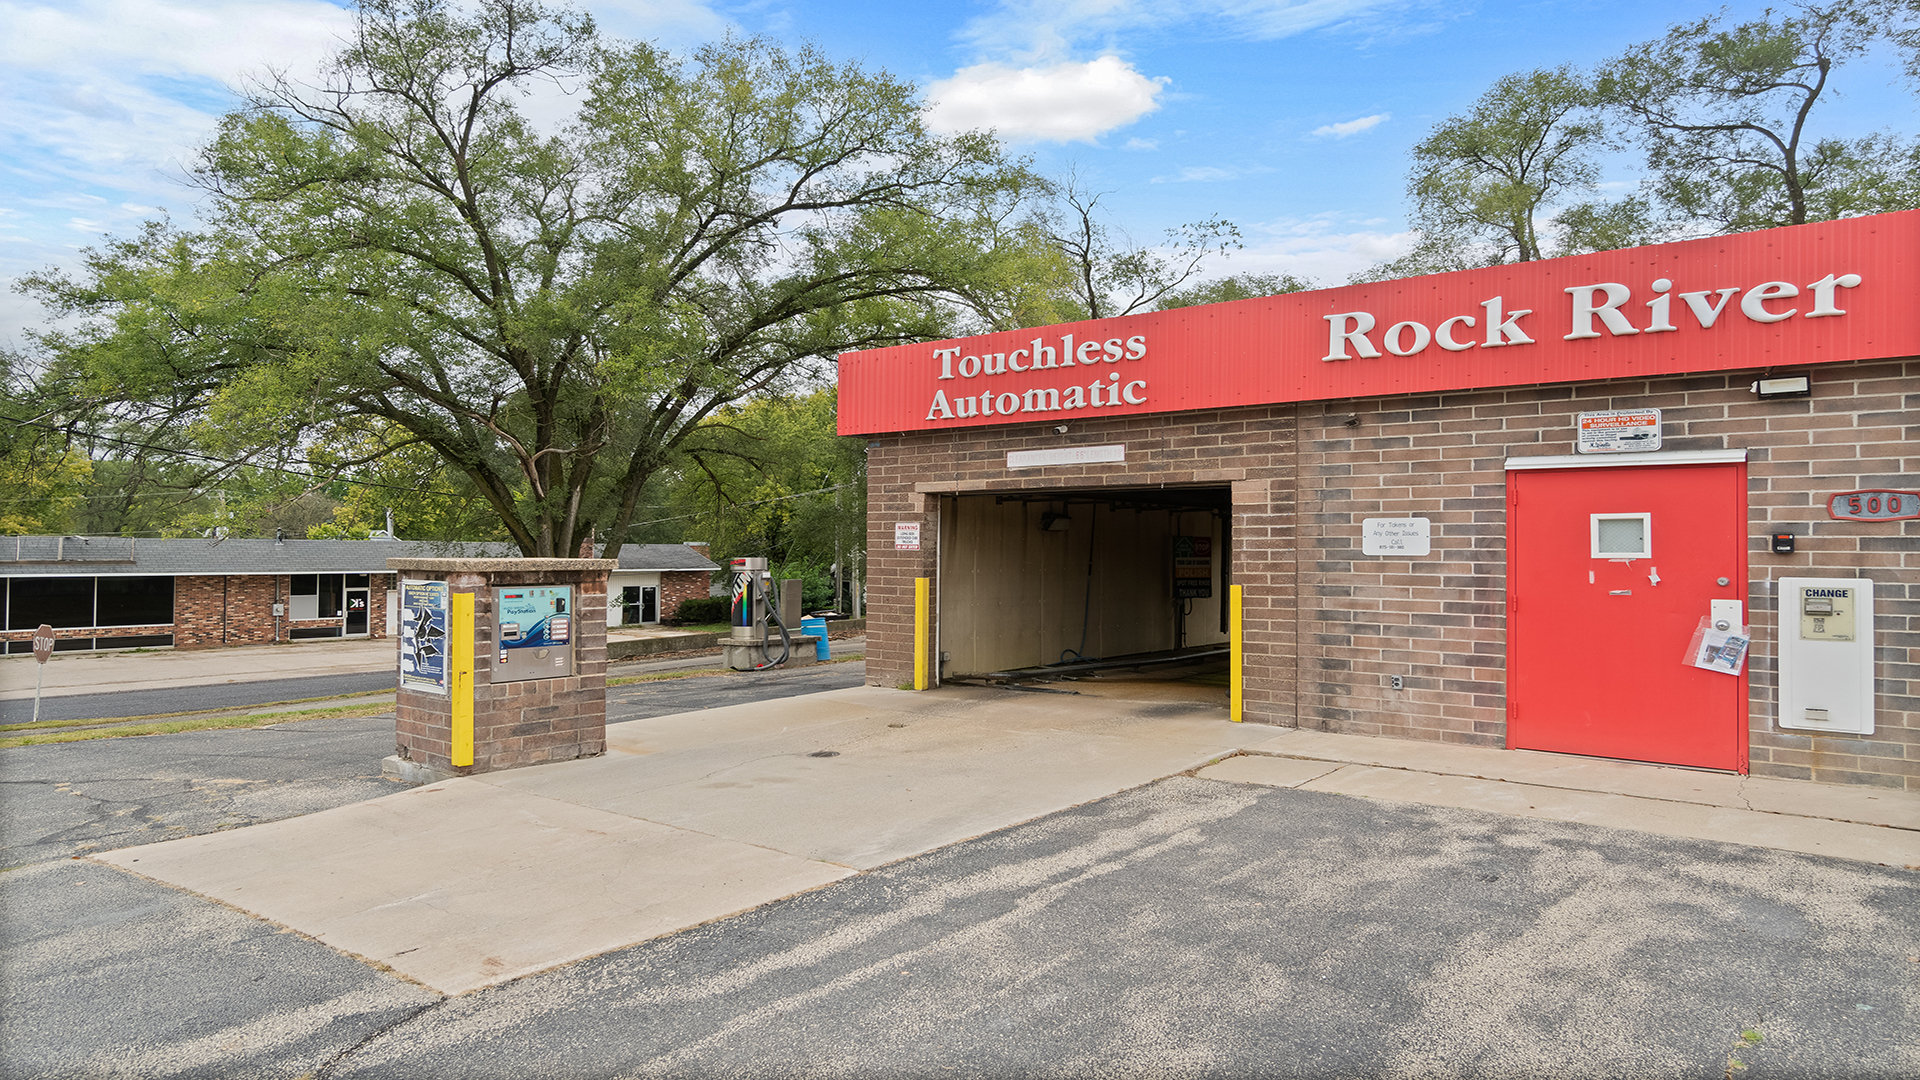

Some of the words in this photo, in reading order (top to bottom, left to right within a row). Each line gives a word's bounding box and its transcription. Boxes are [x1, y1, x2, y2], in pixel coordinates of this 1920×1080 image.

[1321, 296, 1535, 362] Rock
[1563, 273, 1862, 342] River
[932, 333, 1148, 380] Touchless
[925, 372, 1148, 421] Automatic
[1086, 449, 1112, 460] LENGTH
[1848, 496, 1902, 514] 500
[1178, 568, 1208, 577] POLISH
[1179, 588, 1198, 597] THANK
[1198, 588, 1210, 597] YOU
[1805, 589, 1848, 598] CHANGE
[34, 636, 54, 651] STOP
